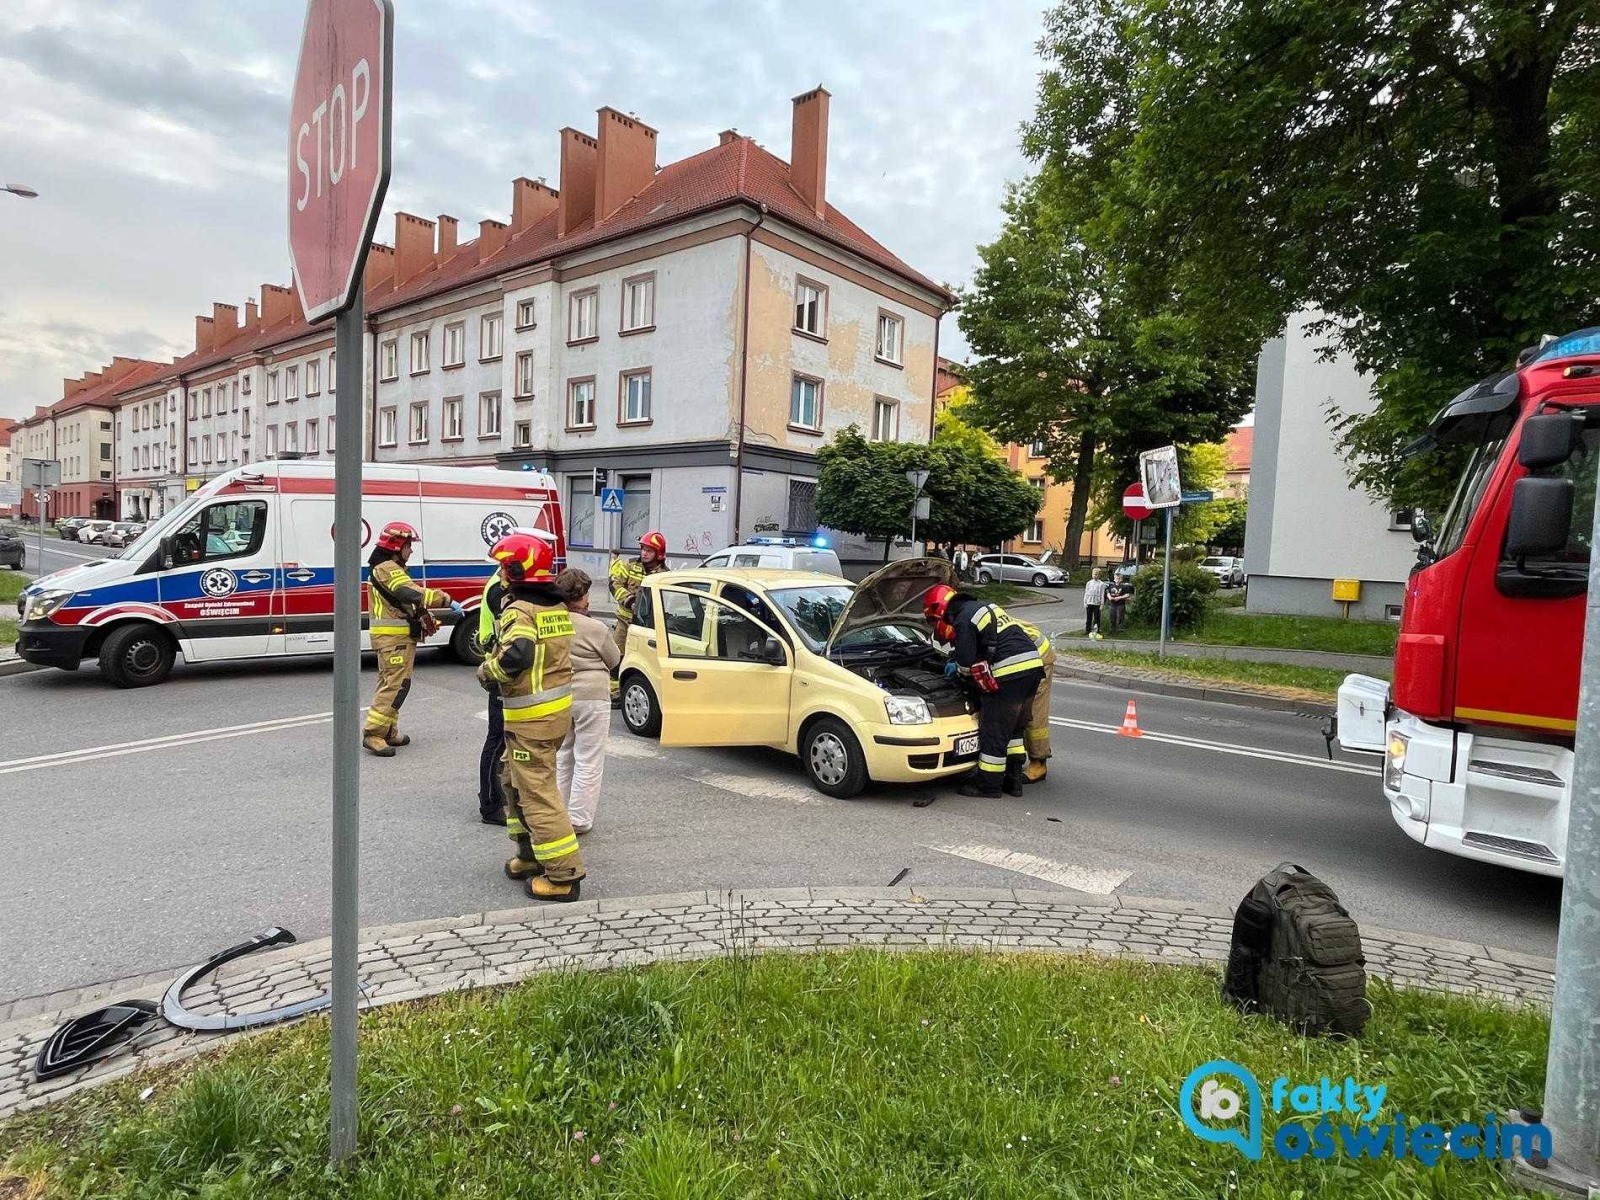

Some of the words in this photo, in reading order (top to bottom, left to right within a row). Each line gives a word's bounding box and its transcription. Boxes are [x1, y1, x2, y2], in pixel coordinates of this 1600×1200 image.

[297, 58, 371, 212] STOP
[200, 607, 240, 617] OŚWIĘCIM
[515, 752, 528, 760] PSP
